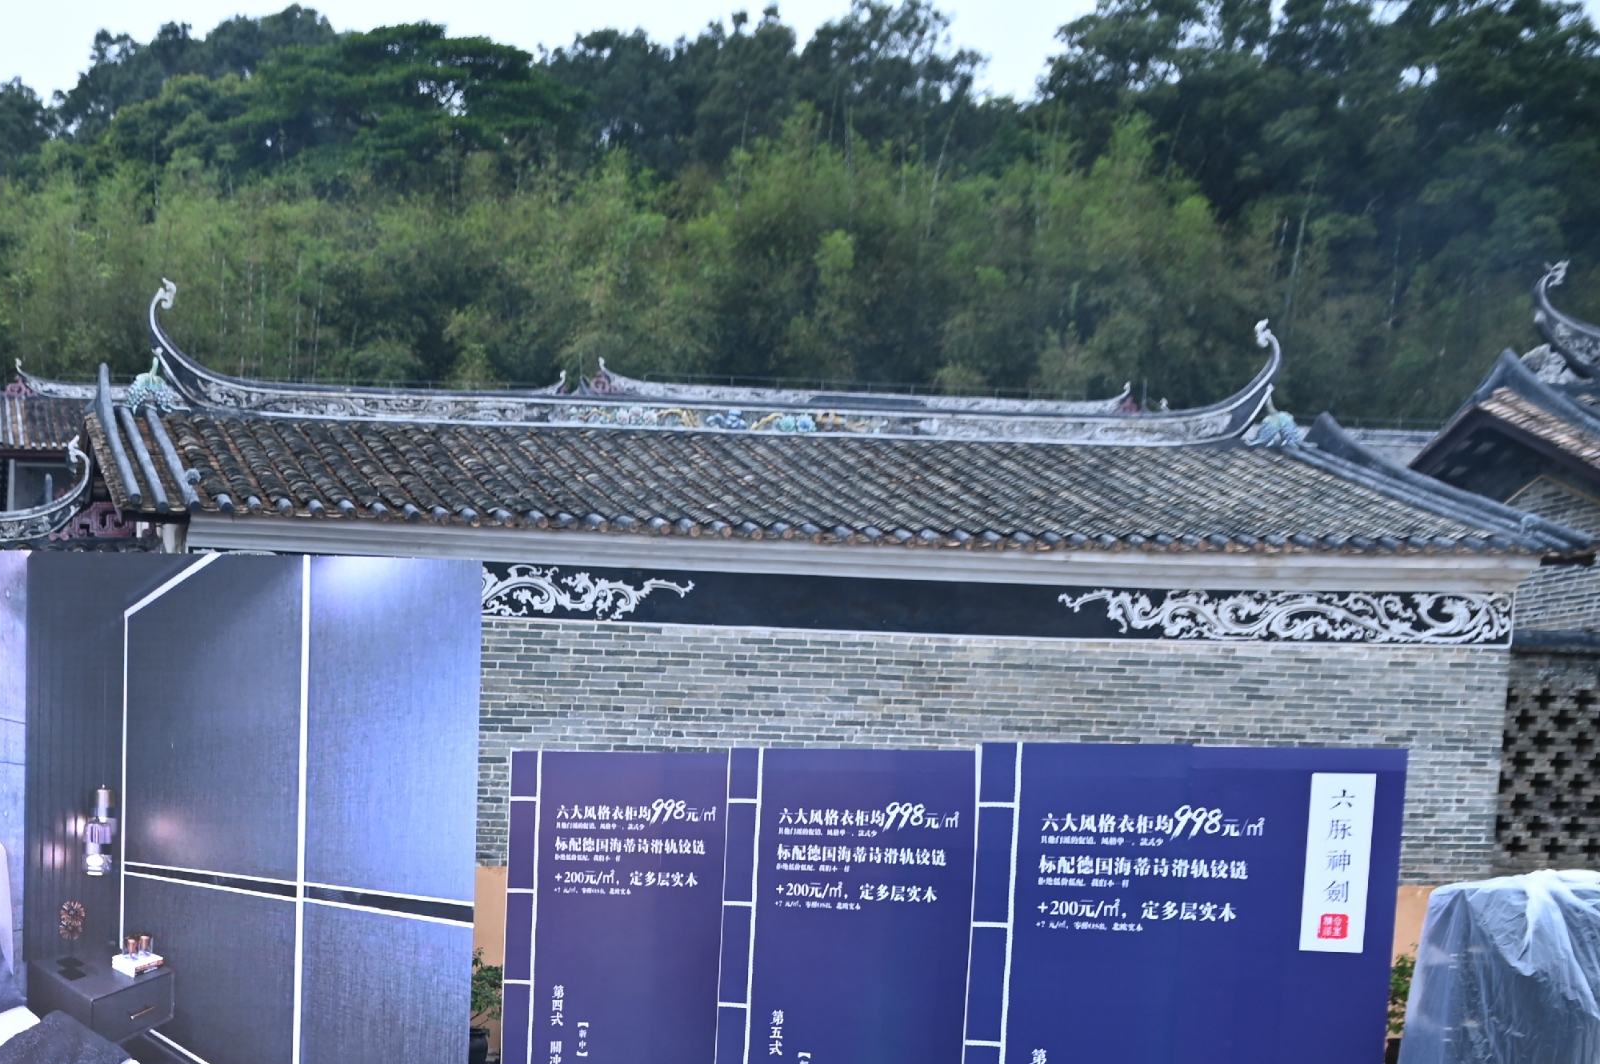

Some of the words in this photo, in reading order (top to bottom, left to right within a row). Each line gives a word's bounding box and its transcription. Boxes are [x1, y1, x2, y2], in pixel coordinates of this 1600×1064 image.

[555, 836, 706, 855] 标配德国海蒂诗滑轨铰链
[776, 844, 947, 867] 标配德国海蒂诗滑轨铰链
[1038, 855, 1249, 880] 标配德国海蒂诗滑轨铰链
[551, 985, 565, 1026] 第四式
[769, 1009, 784, 1056] 第五式
